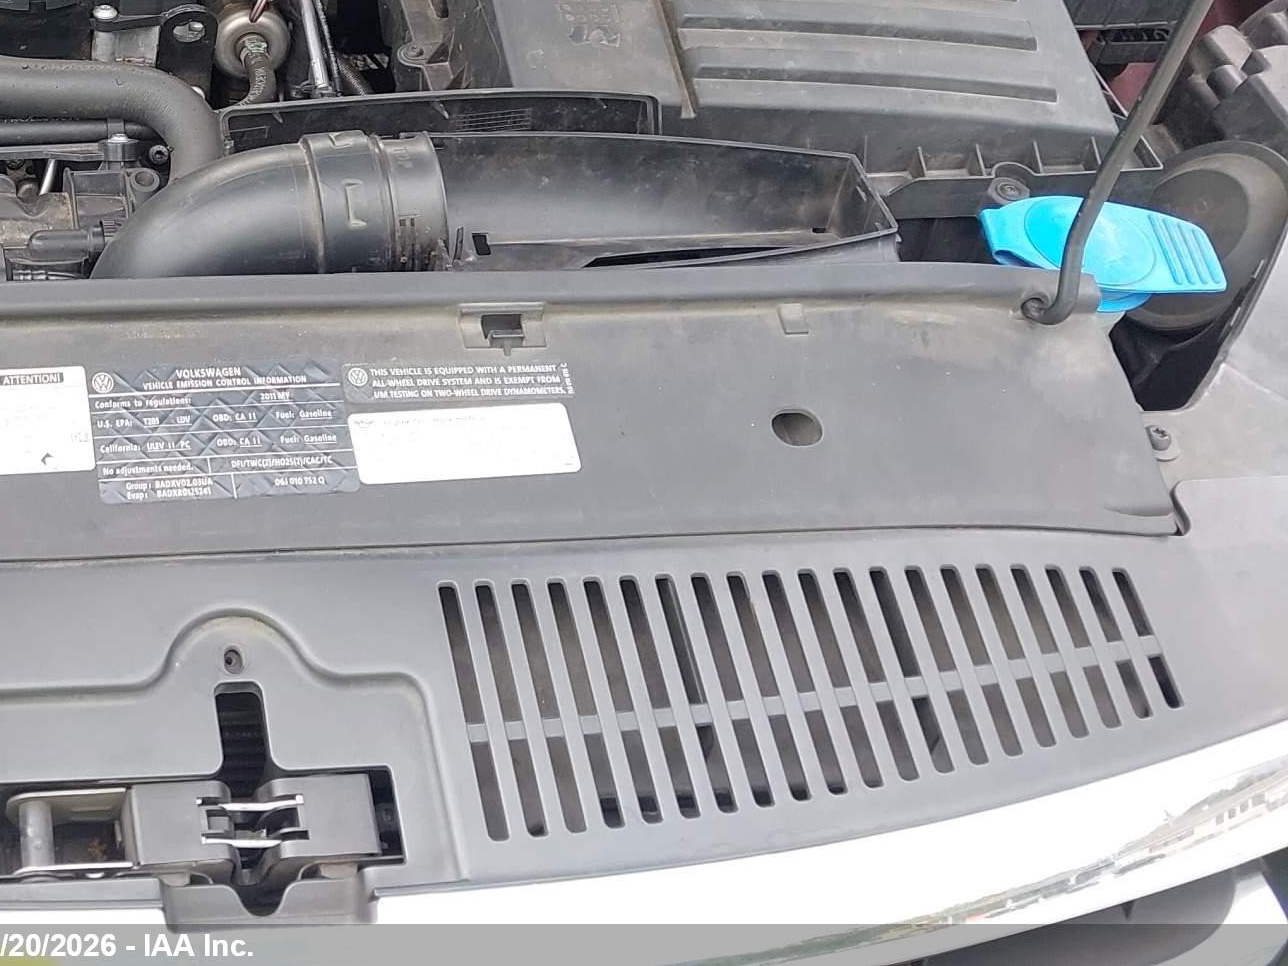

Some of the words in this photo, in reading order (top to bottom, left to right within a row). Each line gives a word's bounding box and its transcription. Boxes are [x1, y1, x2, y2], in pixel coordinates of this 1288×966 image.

[176, 367, 242, 379] VOLKSWAGEN
[370, 368, 388, 376] THIS
[391, 368, 422, 376] VEHICLE
[424, 367, 432, 375] IS
[434, 366, 474, 375] EQUIPPED
[475, 366, 497, 374] WITH
[500, 365, 506, 373] A
[508, 364, 557, 373] PERMANENT
[4, 372, 62, 385] ATTENTION!
[143, 381, 174, 390] VEHICLE
[177, 379, 212, 388] EMISSION
[215, 377, 251, 387] CONTROL
[254, 375, 307, 384] INFORMATION
[372, 378, 415, 388] ALL-WHEEL
[417, 378, 440, 386] DRIVE
[442, 377, 472, 386] SYSTEM
[475, 377, 492, 385] AND
[494, 376, 502, 384] IS
[504, 376, 534, 384] EXEMPT
[537, 375, 561, 384] FROM
[390, 389, 419, 398] TESTING
[421, 389, 433, 397] ON
[434, 388, 479, 397] TWO-WHEEL
[480, 388, 502, 396] DRIVE
[504, 386, 567, 396] DYNAMOMETERS.
[94, 400, 131, 409] Conforms
[134, 399, 143, 407] to
[145, 397, 192, 408] regulations:
[176, 415, 192, 424] LDV
[212, 413, 232, 422] OBD:
[235, 412, 247, 420] CA
[275, 410, 295, 419] Fuel:
[299, 409, 333, 418] Gasoline
[96, 419, 113, 428] U.S.
[115, 419, 133, 427] EPA:
[240, 437, 251, 446] CA
[280, 435, 300, 444] Fuel:
[304, 434, 337, 443] Gasoline
[100, 443, 141, 453] California:
[179, 440, 192, 449] PC
[103, 467, 113, 475] No
[115, 464, 162, 475] adjustments
[163, 462, 194, 472] needed.
[125, 481, 152, 491] Group:
[126, 491, 148, 500] Evap:
